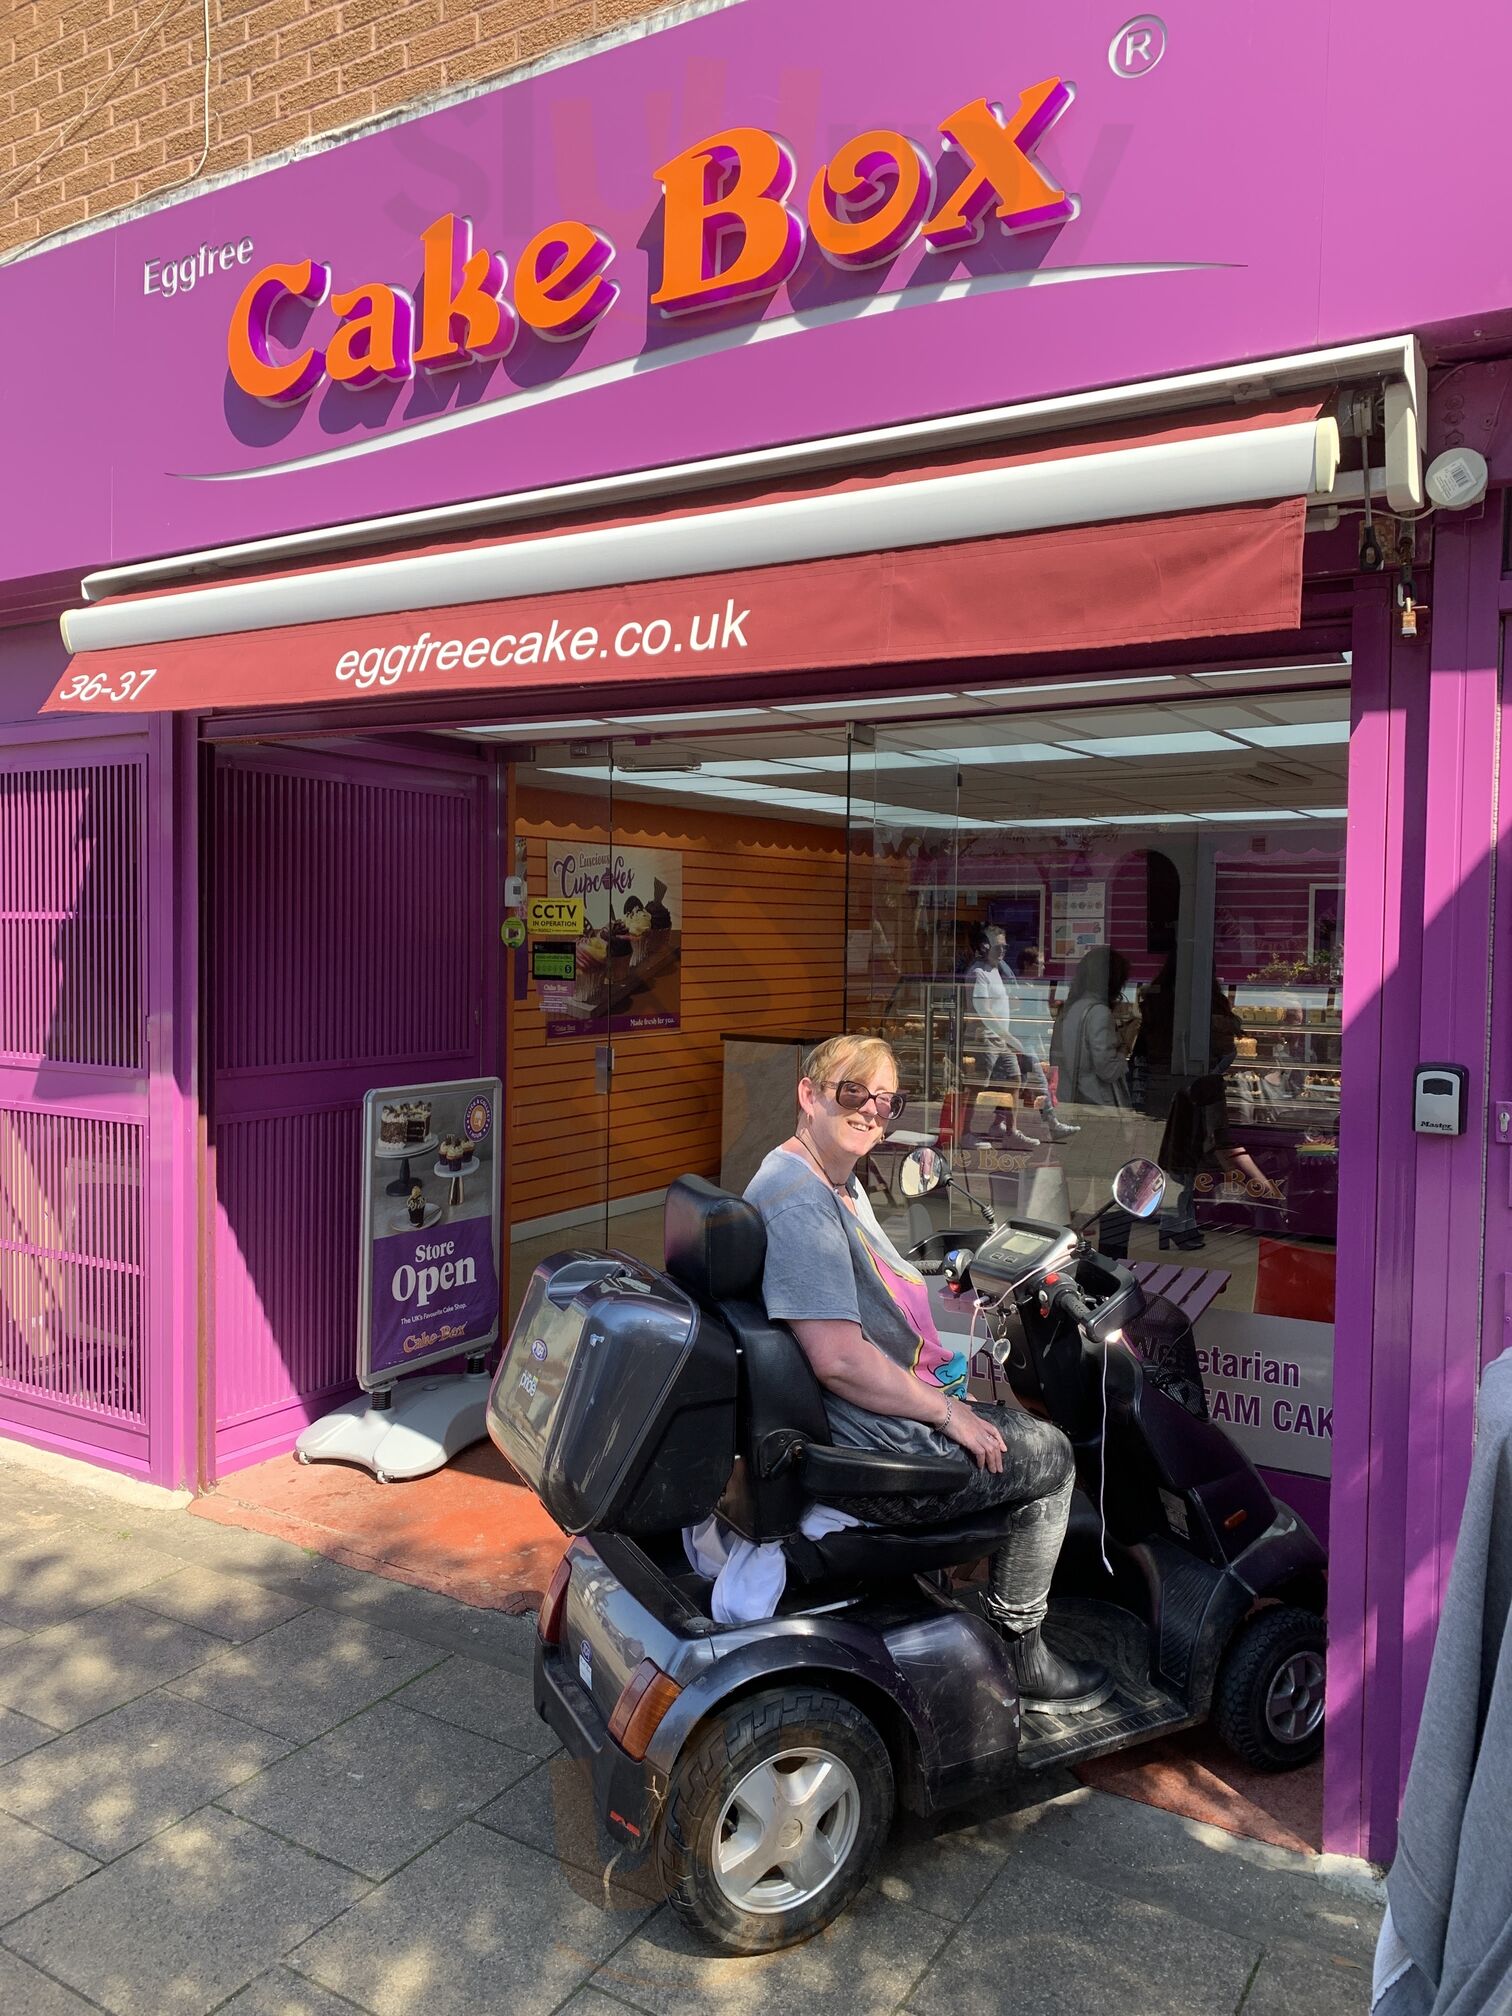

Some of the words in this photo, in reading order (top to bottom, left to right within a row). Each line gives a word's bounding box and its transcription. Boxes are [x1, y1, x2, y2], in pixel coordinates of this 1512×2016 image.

[226, 212, 620, 407] Cake
[649, 75, 1080, 322] Box
[143, 235, 254, 298] Eggfree
[334, 598, 750, 689] eggfreecake.co.uk
[59, 668, 158, 702] 36-37
[532, 904, 577, 919] CCTV
[1420, 1121, 1452, 1129] Master
[977, 1147, 1033, 1172] Box
[1220, 1169, 1287, 1200] Box
[415, 1240, 455, 1263] Store
[391, 1256, 477, 1307] Open
[400, 1317, 411, 1325] The
